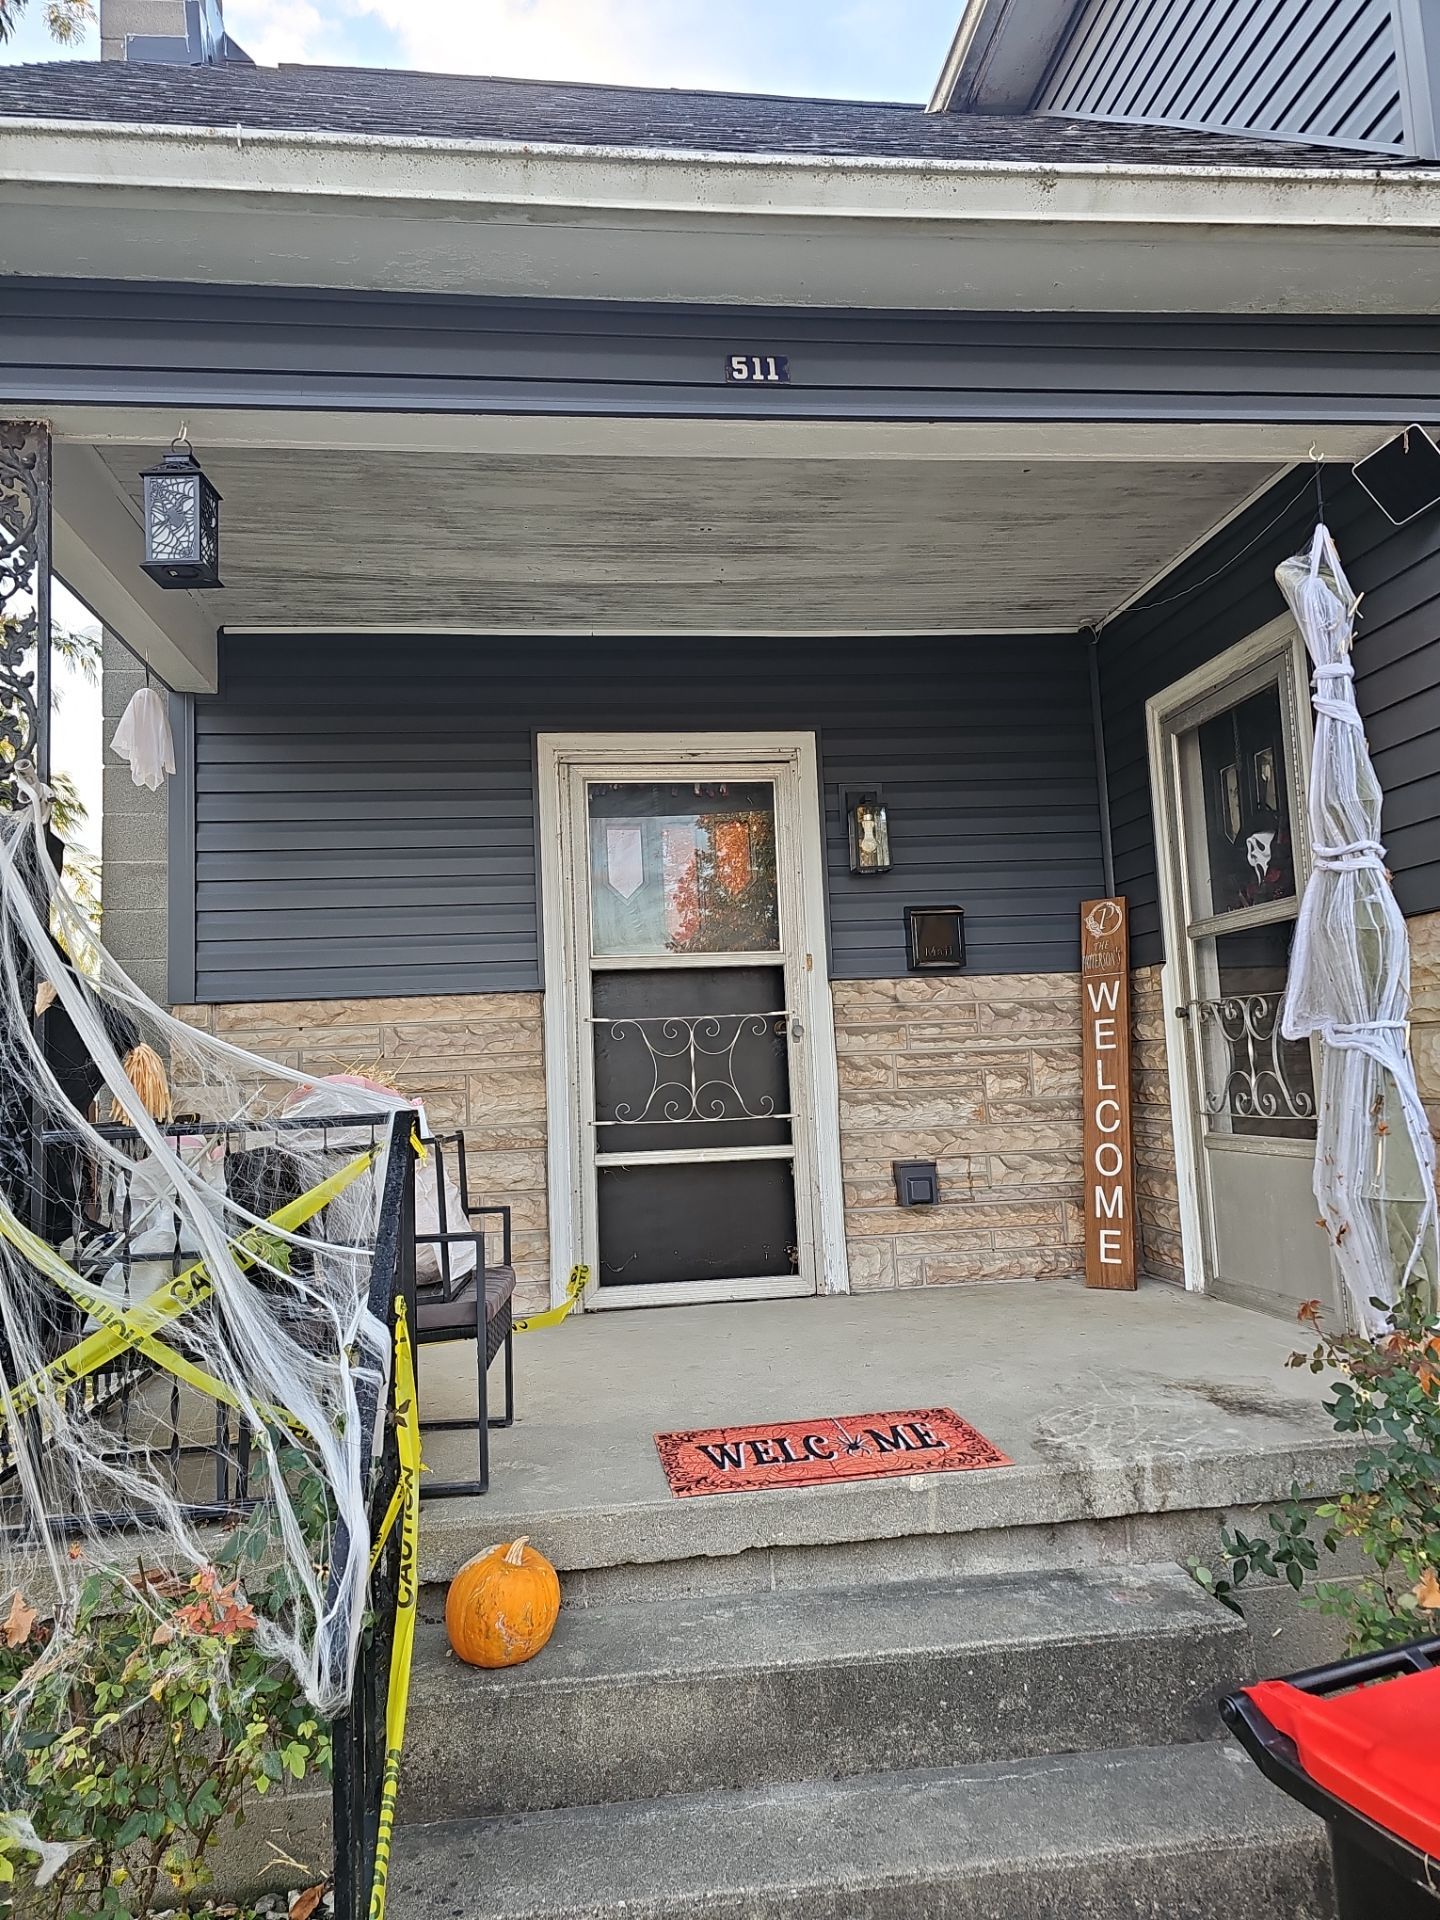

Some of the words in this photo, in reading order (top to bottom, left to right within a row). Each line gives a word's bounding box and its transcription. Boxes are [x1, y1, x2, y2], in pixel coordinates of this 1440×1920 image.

[731, 356, 779, 380] 511
[1094, 940, 1110, 951] THE
[1087, 980, 1124, 1264] WELCOME
[695, 1423, 946, 1471] WELCME
